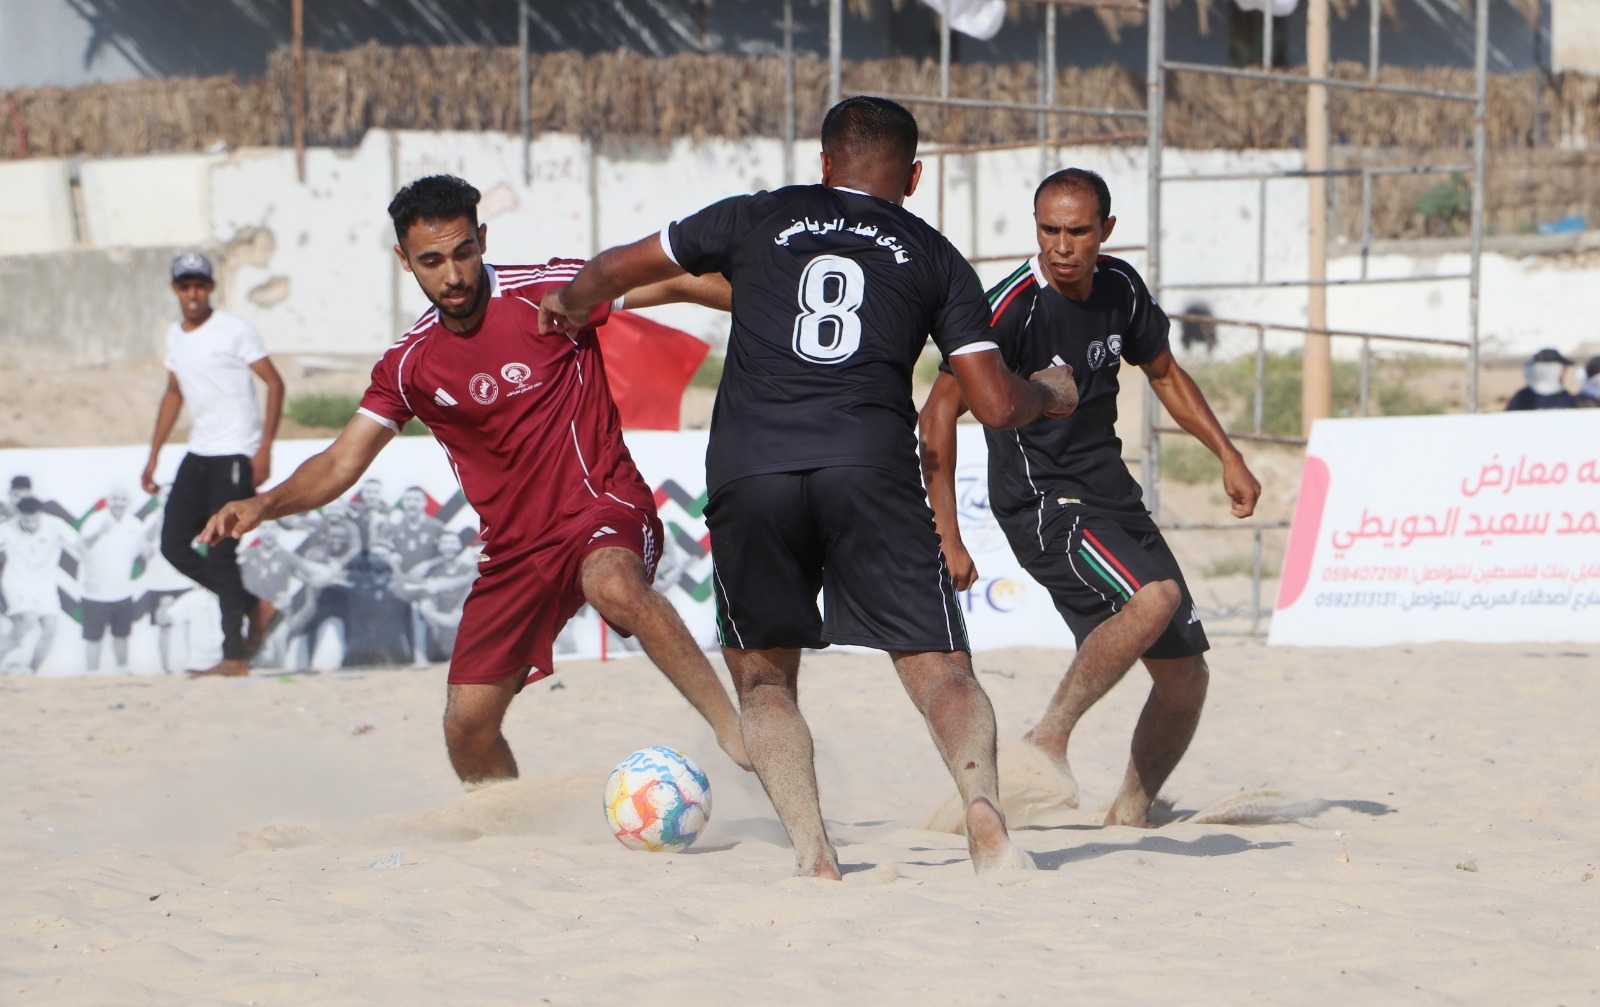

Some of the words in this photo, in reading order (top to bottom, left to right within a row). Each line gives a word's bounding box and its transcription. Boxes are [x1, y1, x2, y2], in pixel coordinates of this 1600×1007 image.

[774, 216, 845, 247] الرياضي
[845, 222, 879, 238] نماء
[792, 254, 865, 364] 8
[1461, 453, 1569, 497] معارض
[1331, 506, 1461, 560] الحويطي
[1464, 511, 1551, 547] سعيد
[1556, 511, 1600, 536] مد
